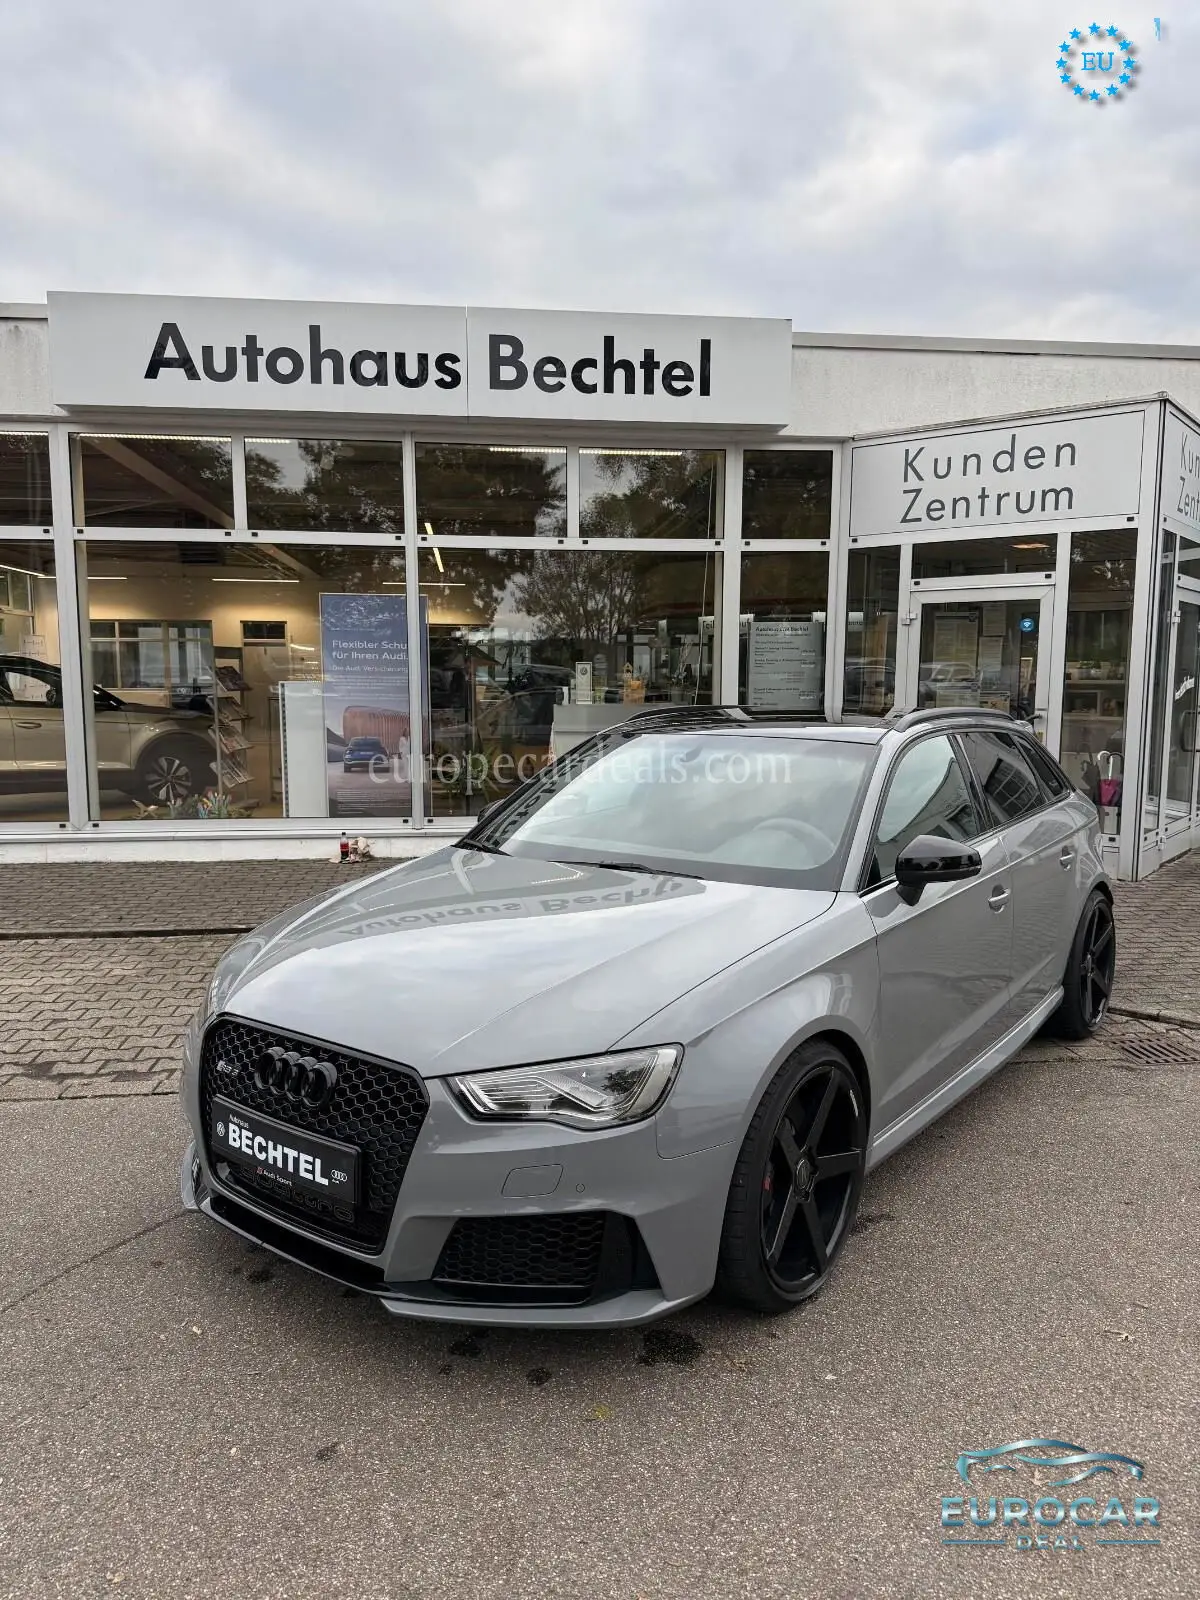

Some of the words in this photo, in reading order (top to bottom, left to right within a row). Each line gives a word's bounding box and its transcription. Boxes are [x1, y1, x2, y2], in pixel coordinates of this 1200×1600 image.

[143, 322, 461, 391] Autohaus
[488, 333, 712, 398] Bechtel
[903, 433, 1077, 483] Kunden
[901, 485, 1074, 524] Zentrum
[332, 639, 379, 650] Flexibler
[332, 651, 349, 660] für
[351, 651, 379, 660] Ihren
[228, 1122, 329, 1186] BECHTEL
